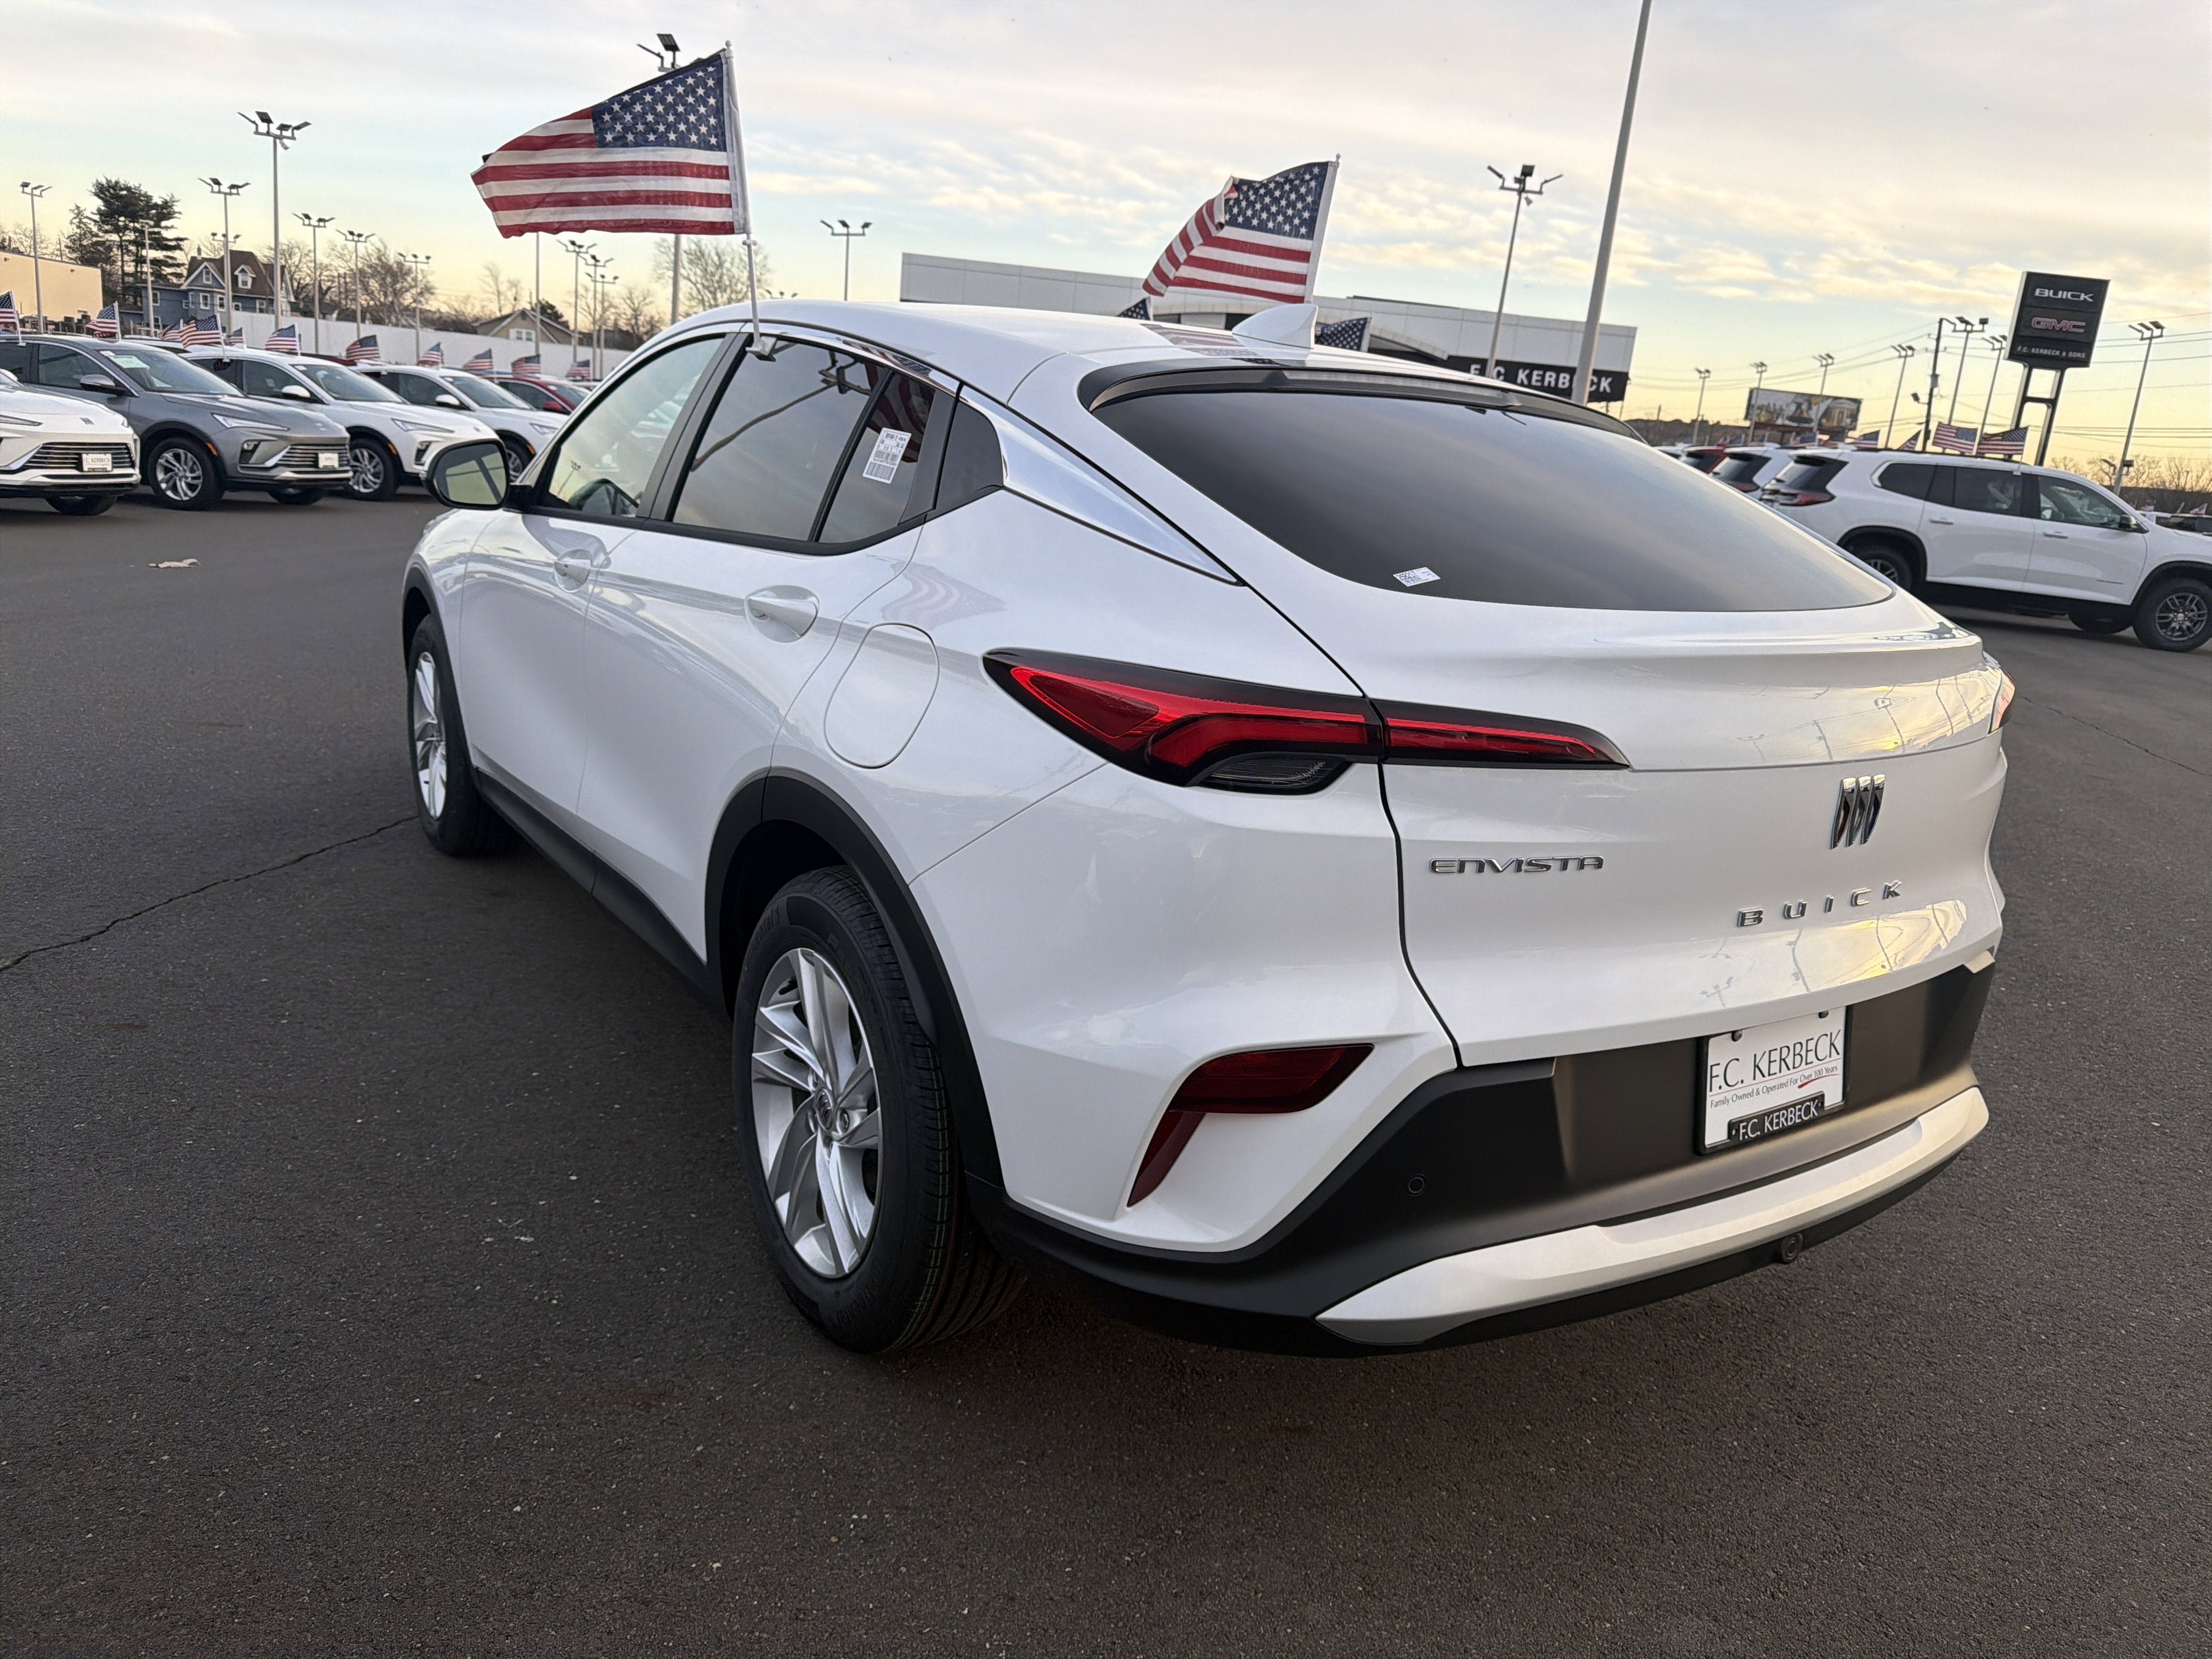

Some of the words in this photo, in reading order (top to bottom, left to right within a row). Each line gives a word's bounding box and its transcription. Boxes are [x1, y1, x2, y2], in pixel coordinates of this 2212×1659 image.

[2035, 288, 2094, 302] BUICK
[2032, 317, 2086, 332] GMC
[1517, 368, 1613, 393] KERBCK
[1430, 855, 1604, 873] ENVISTA
[1737, 879, 1903, 927] BUICK
[1709, 1058, 1744, 1092] F.C.
[1752, 1029, 1841, 1081] KERBECK
[1710, 1097, 1730, 1108] Family
[1731, 1090, 1754, 1103] Owned
[1762, 1081, 1788, 1094] Operated
[1790, 1078, 1798, 1086] For
[1799, 1074, 1813, 1082] Over
[1814, 1069, 1824, 1077] 100
[1824, 1065, 1838, 1075] Years
[1739, 1119, 1760, 1141] F.C.
[1764, 1099, 1819, 1133] KERBECK
